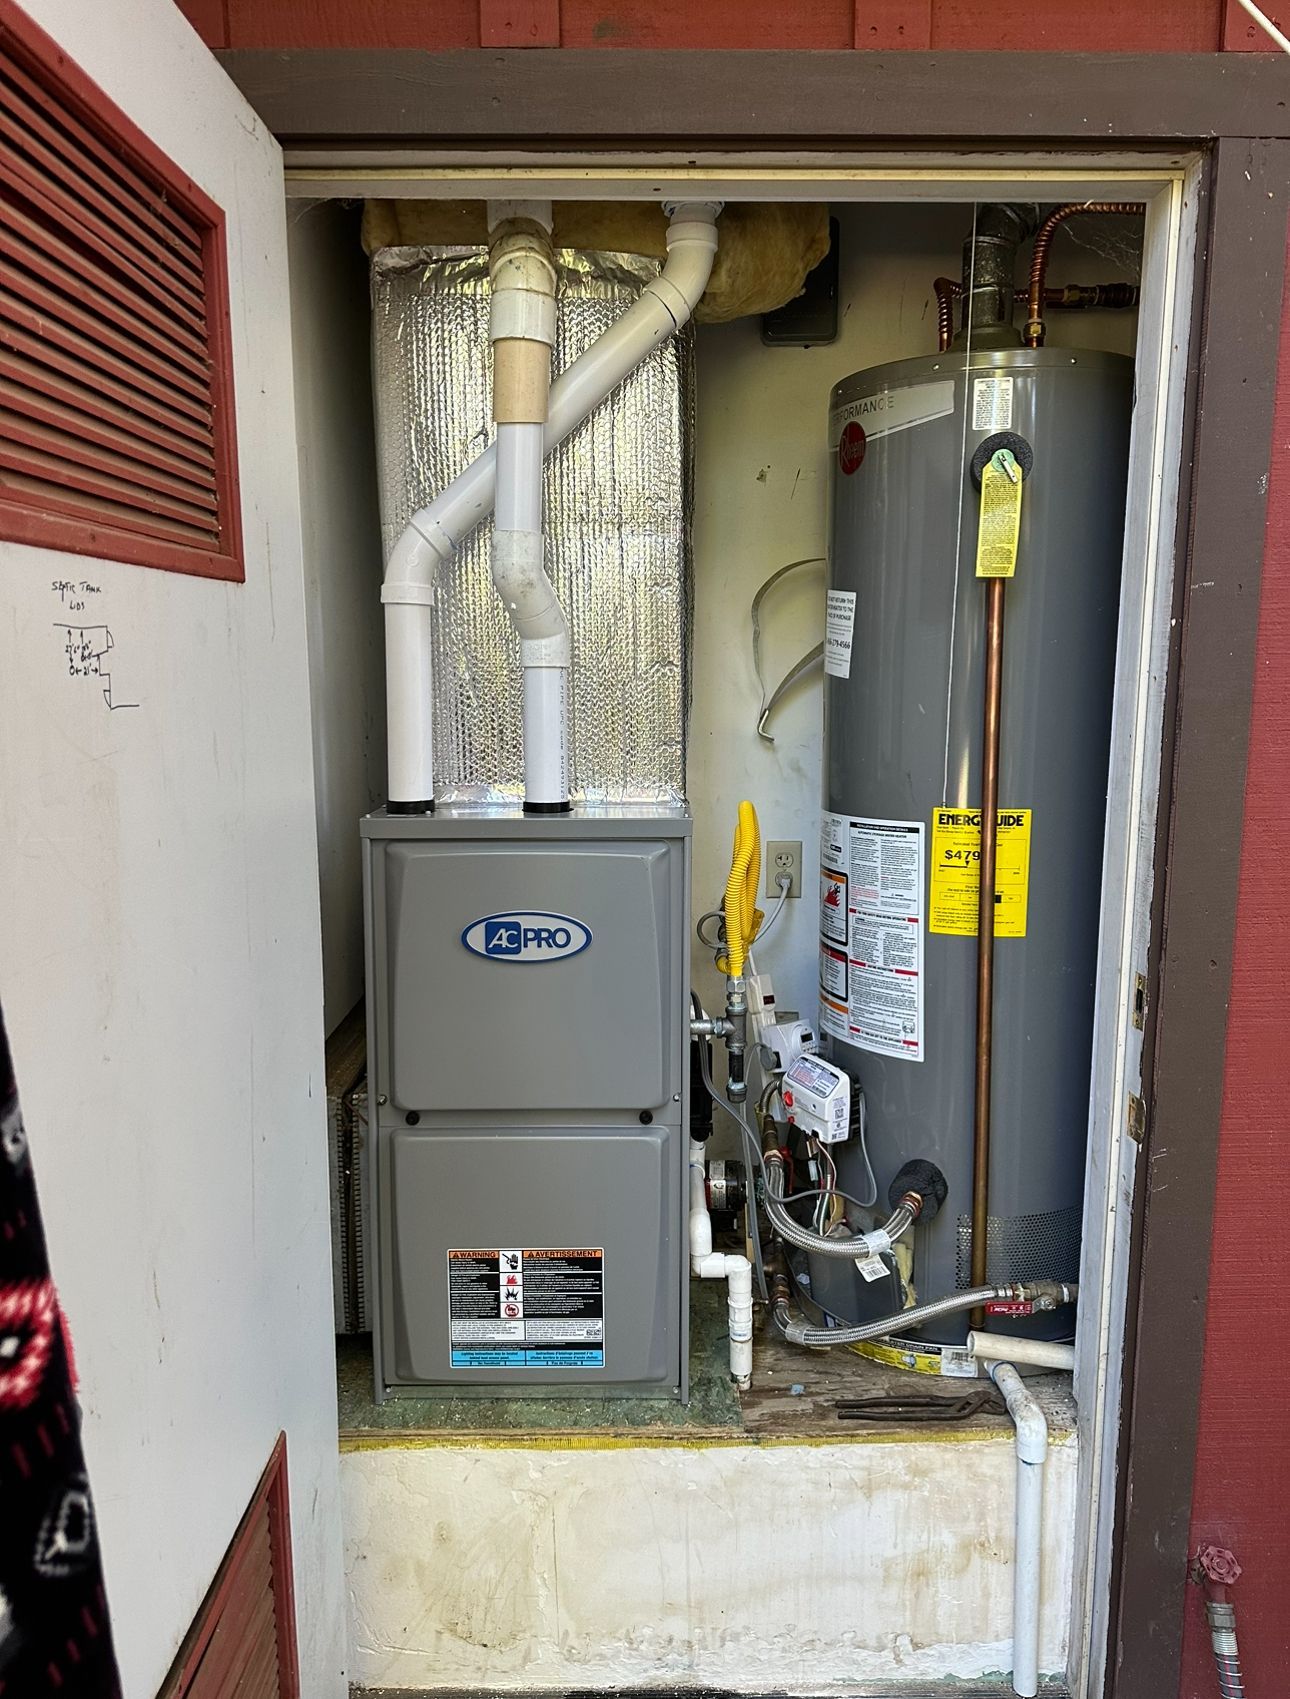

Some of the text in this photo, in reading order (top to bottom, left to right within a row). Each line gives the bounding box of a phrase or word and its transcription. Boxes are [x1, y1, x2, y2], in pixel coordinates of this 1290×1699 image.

[840, 396, 895, 420] FORMANCE
[938, 813, 1024, 827] ENERGUIDE
[488, 927, 572, 949] AC PRO
[535, 1250, 598, 1258] AVERTISSEMENT
